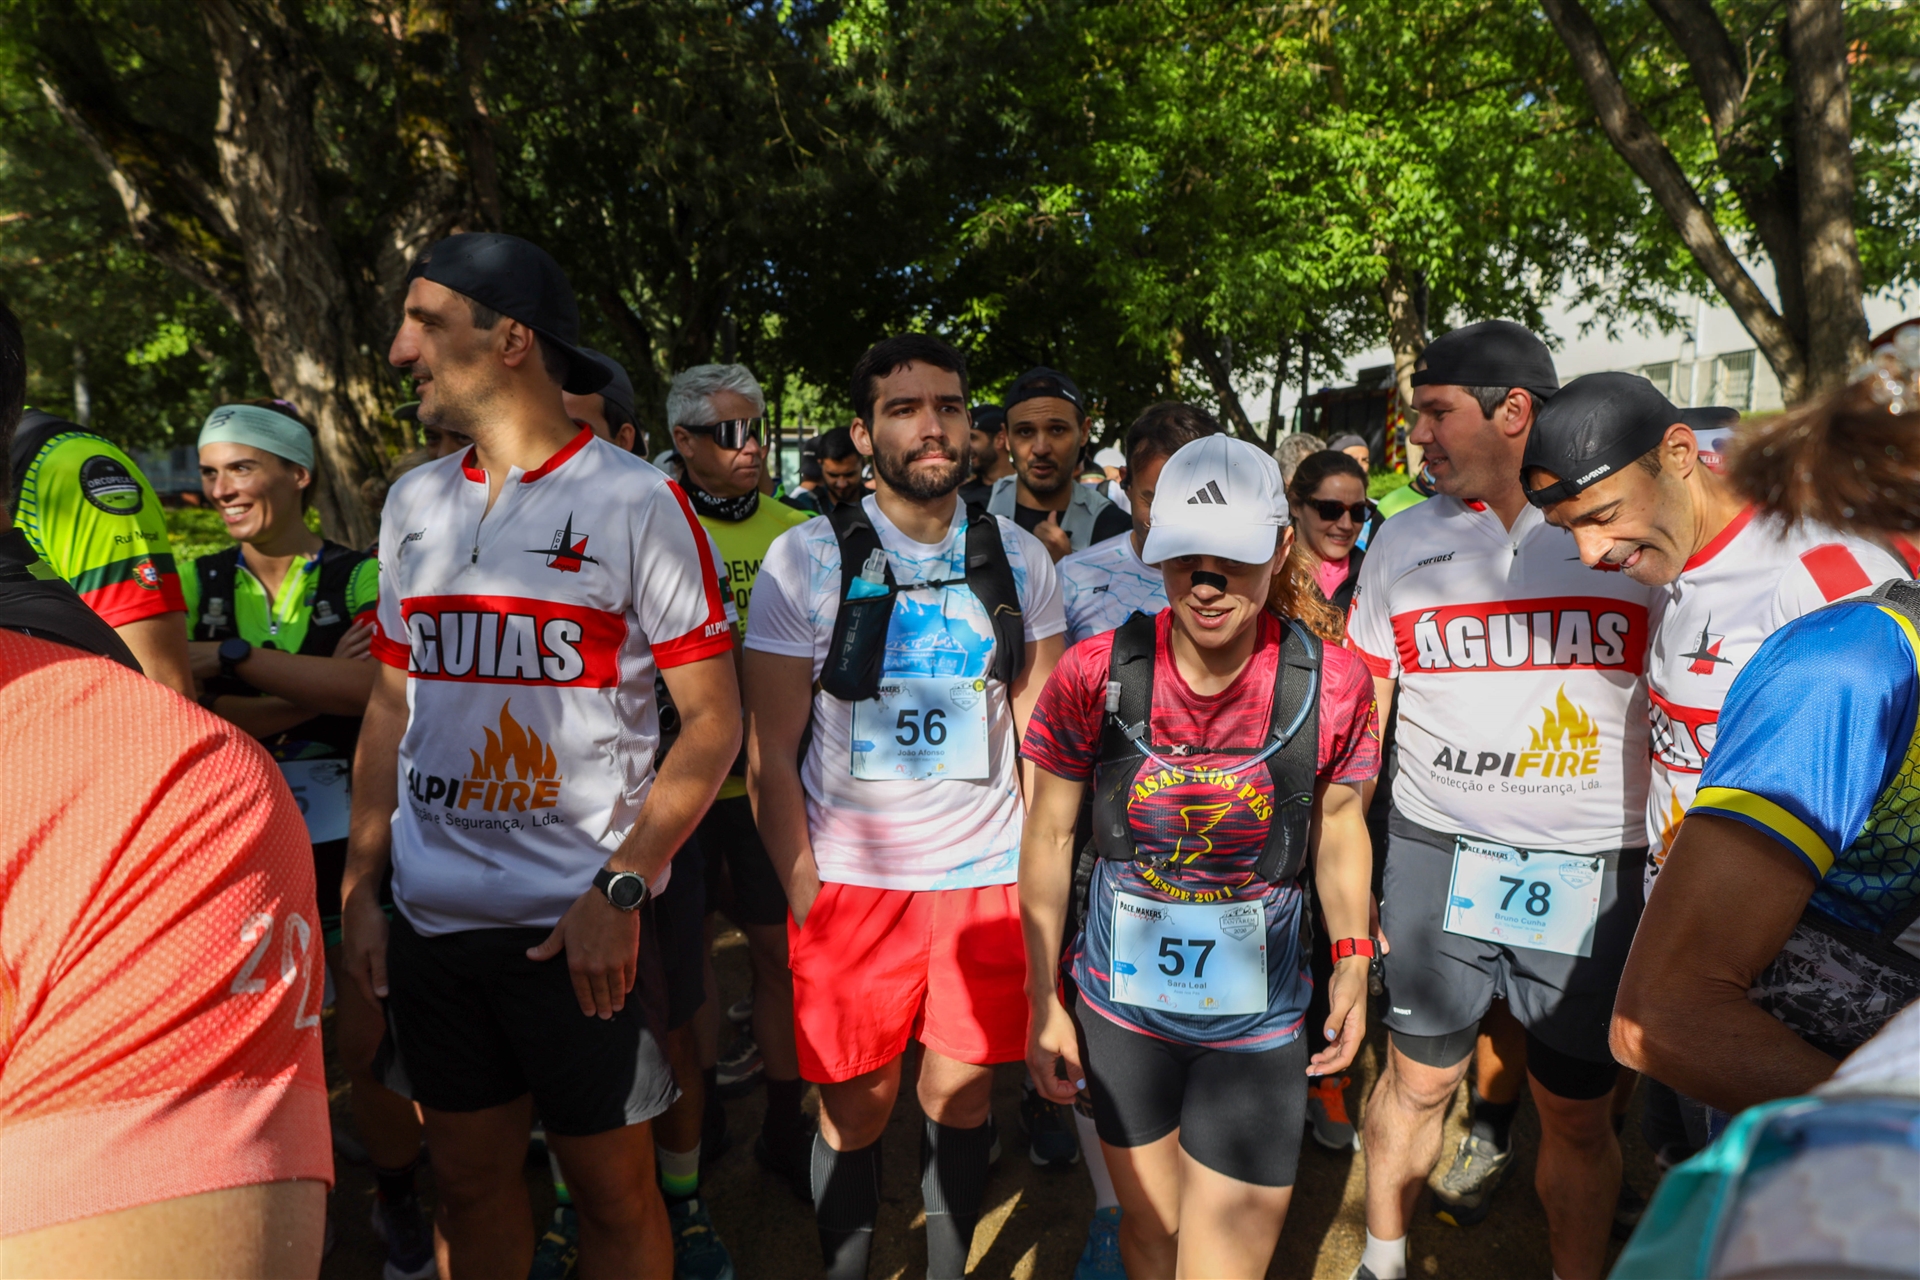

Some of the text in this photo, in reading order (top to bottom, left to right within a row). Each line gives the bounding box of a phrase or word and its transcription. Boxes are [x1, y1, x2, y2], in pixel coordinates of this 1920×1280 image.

[114, 533, 133, 545] Rui
[405, 611, 585, 683] GUIAS
[1414, 610, 1630, 669] ÁGUIAS
[884, 655, 958, 669] SANTARÉM
[895, 709, 948, 746] 56
[897, 749, 945, 757] João Afonso
[1432, 745, 1601, 778] ALPIFIRE
[1134, 765, 1274, 822] ASAS NOS PÉS
[1430, 770, 1602, 796] Protecção e Segurança, Lda.
[446, 813, 526, 834] Segurança,
[532, 812, 565, 828] Lda.
[1142, 868, 1234, 903] DESDE 2011
[1499, 875, 1552, 917] 78
[1494, 912, 1519, 923] Bruno
[1521, 917, 1547, 927] Cunha
[1157, 936, 1216, 978] 57
[1167, 979, 1207, 990] Sara Leal
